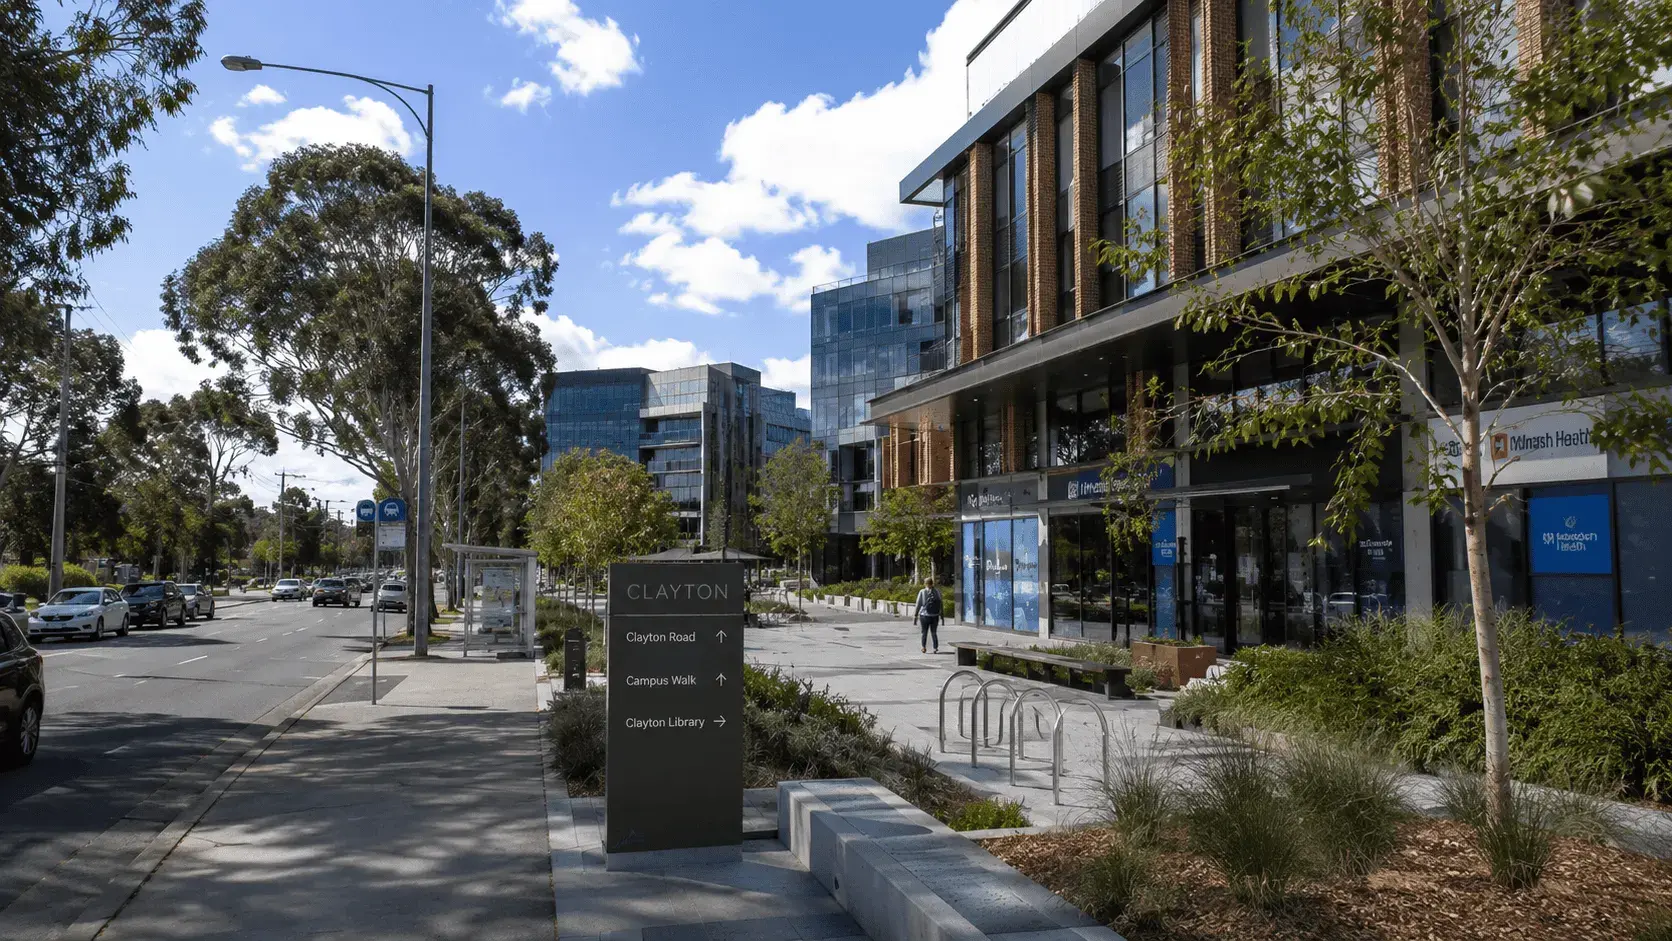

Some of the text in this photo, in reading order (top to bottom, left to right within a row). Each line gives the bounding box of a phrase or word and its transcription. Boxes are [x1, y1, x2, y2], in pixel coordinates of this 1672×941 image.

[626, 583, 728, 600] CLAYTON
[626, 631, 696, 645] Clayton Road
[626, 674, 697, 688] Campus Walk
[625, 716, 706, 730] Clayton Library
